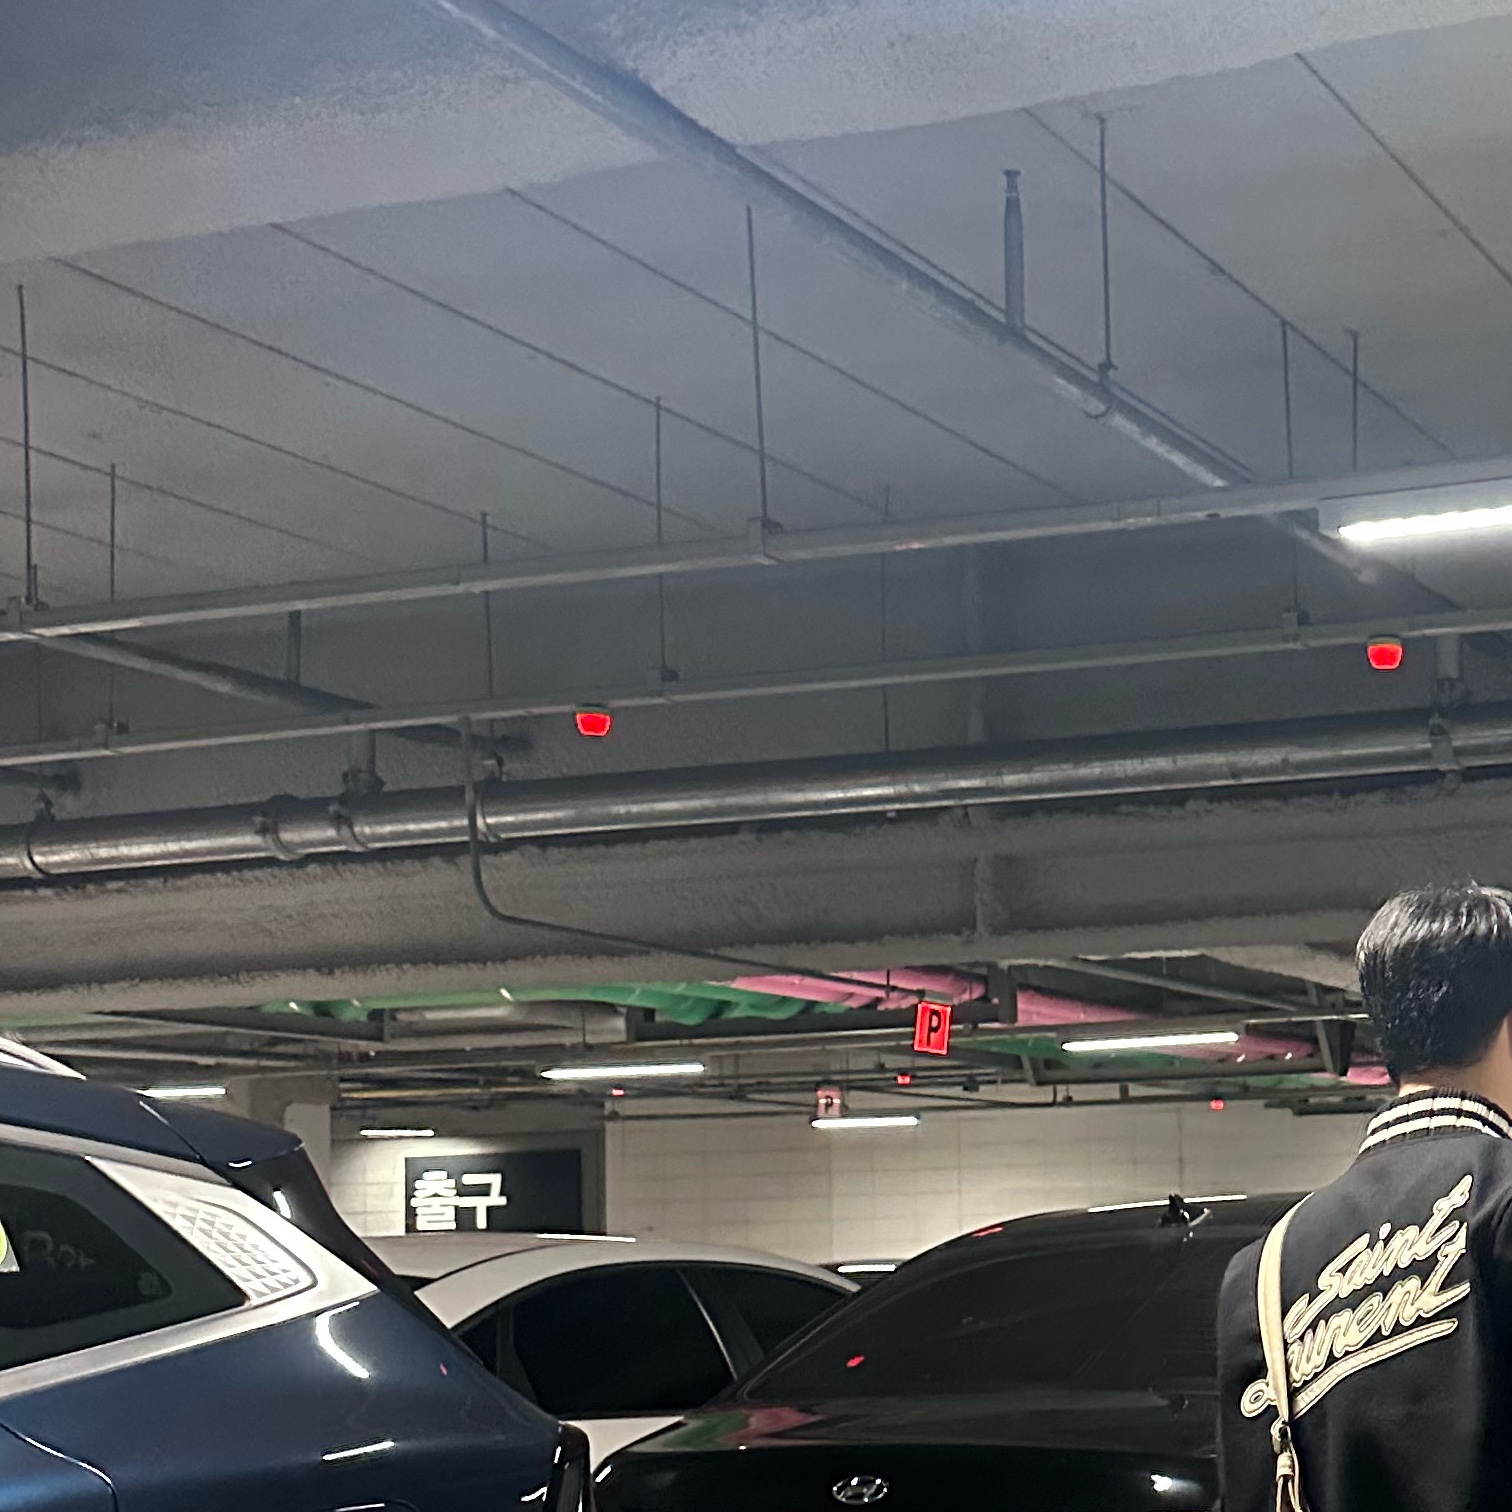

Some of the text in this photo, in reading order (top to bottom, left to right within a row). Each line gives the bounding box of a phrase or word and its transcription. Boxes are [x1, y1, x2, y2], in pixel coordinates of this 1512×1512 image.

[927, 1008, 942, 1047] P
[410, 1169, 507, 1231] 출구
[1284, 1174, 1473, 1343] Saint
